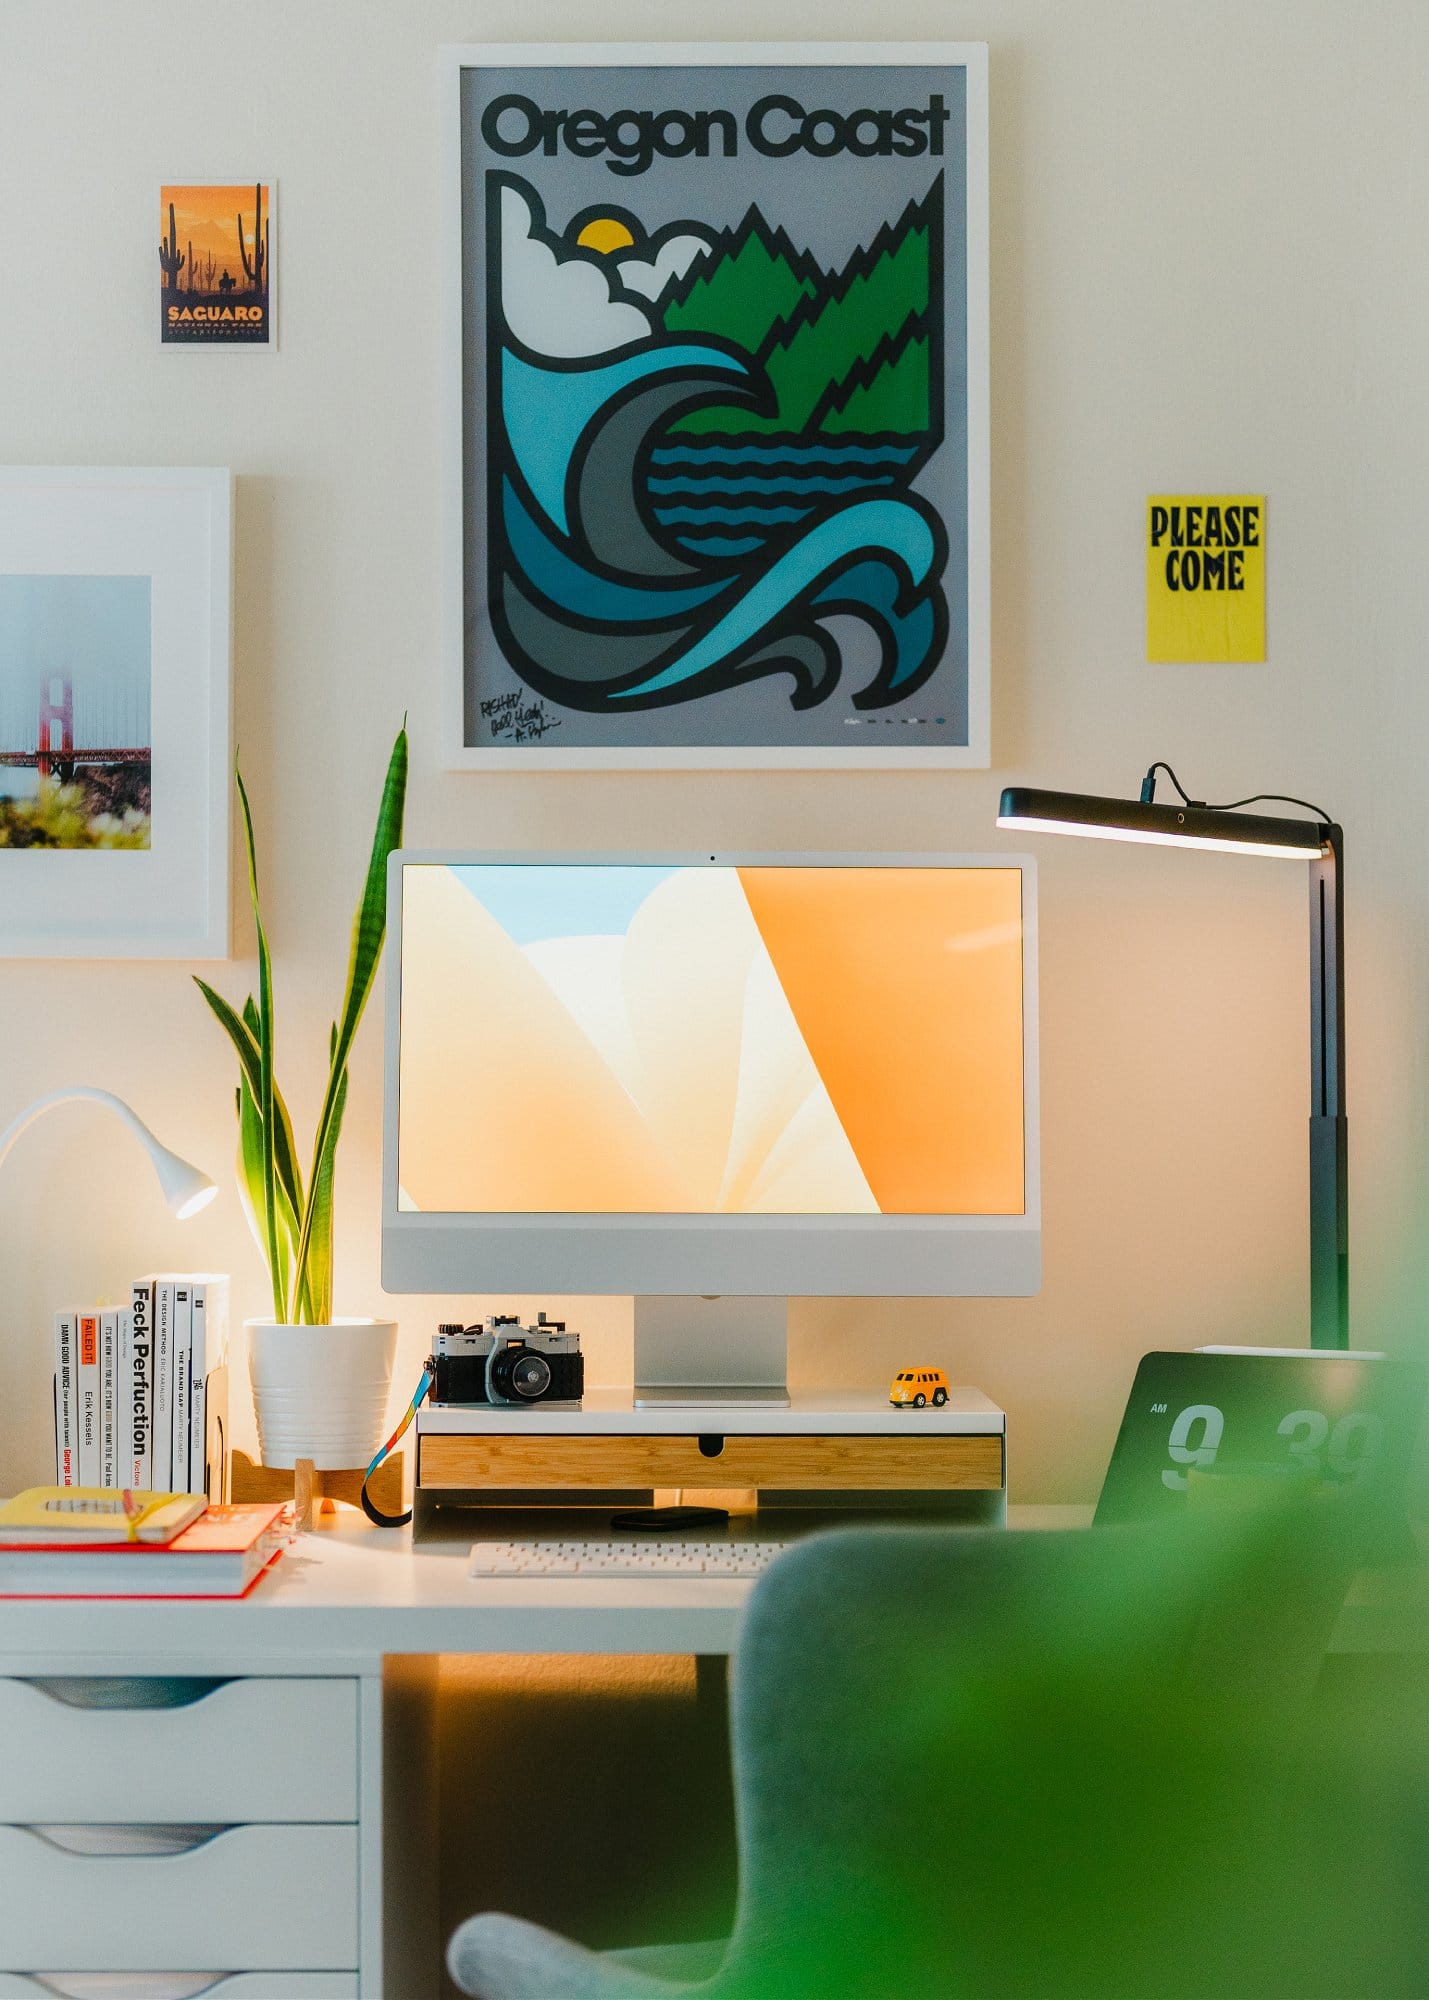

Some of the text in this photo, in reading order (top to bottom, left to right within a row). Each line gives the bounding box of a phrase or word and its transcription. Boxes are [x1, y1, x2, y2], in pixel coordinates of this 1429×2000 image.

[480, 93, 951, 177] Oregon Coast
[168, 306, 263, 321] SAGUARO
[1151, 506, 1259, 547] PLEASE
[1166, 550, 1245, 592] COME
[61, 1324, 69, 1345] DAMN
[84, 1319, 93, 1350] FAILED
[61, 1346, 69, 1364] GOOD
[62, 1366, 70, 1389] ADVICE
[133, 1288, 149, 1486] Feck Perfuction Victore
[85, 1391, 93, 1446] Erik Kessels
[1150, 1403, 1167, 1414] AM
[1161, 1404, 1224, 1491] 9
[63, 1449, 72, 1474] George
[105, 1462, 113, 1472] Paul
[64, 1475, 72, 1488] Loi
